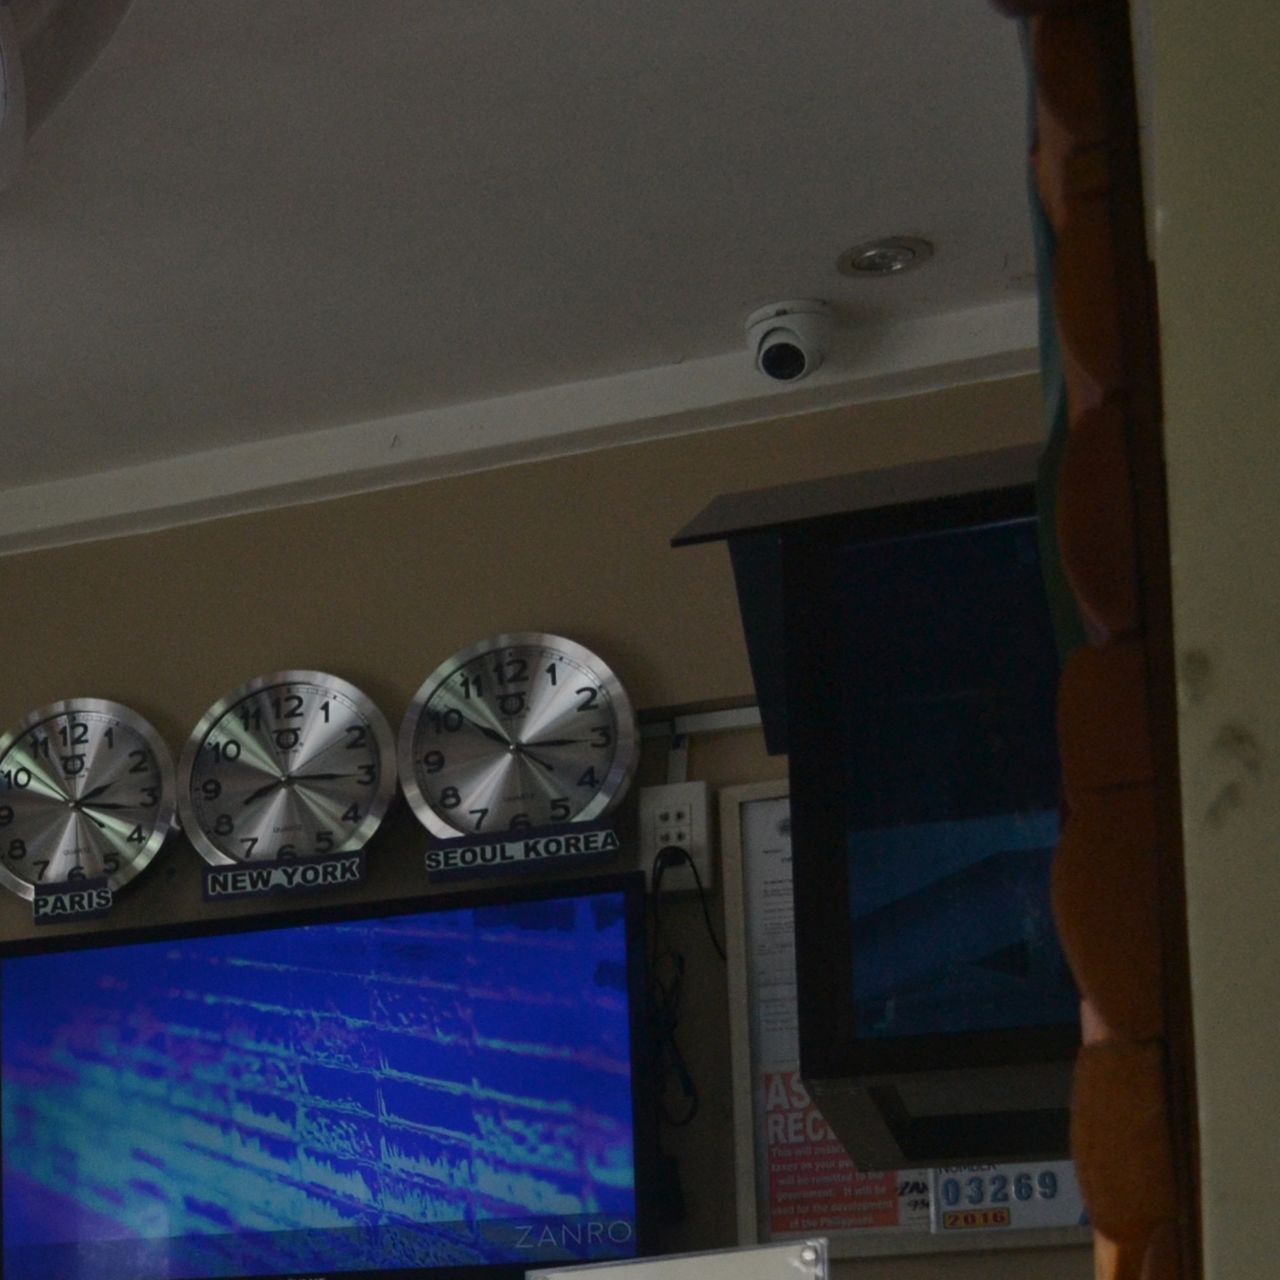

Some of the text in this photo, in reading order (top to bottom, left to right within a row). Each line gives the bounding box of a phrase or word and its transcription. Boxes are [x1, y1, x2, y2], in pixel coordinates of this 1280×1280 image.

[493, 659, 529, 685] 12
[545, 663, 557, 686] 1
[460, 675, 483, 699] 11
[272, 696, 304, 719] 12
[576, 687, 598, 712] 2
[240, 706, 261, 731] 11
[320, 701, 330, 723] 1
[431, 709, 463, 733] 10
[30, 733, 49, 758] 11
[59, 723, 89, 746] 12
[104, 728, 113, 748] 1
[345, 725, 366, 749] 2
[591, 726, 610, 748] 3
[128, 751, 148, 773] 2
[211, 740, 240, 763] 10
[424, 751, 445, 774] 9
[3, 767, 31, 789] 10
[357, 764, 375, 785] 3
[576, 766, 599, 788] 4
[141, 788, 158, 807] 3
[202, 779, 221, 800] 9
[441, 786, 461, 809] 8
[343, 804, 362, 824] 4
[469, 808, 489, 831] 7
[550, 797, 570, 820] 5
[127, 825, 145, 843] 4
[214, 814, 234, 836] 8
[8, 839, 26, 860] 8
[240, 838, 258, 858] 7
[316, 831, 334, 853] 5
[425, 830, 620, 872] SEOUL KOREA
[34, 861, 50, 880] 7
[103, 853, 120, 874] 5
[208, 858, 361, 895] NEW YORK
[33, 889, 113, 916] PARIS
[768, 1111, 837, 1145] REC
[943, 1171, 1059, 1206] 03269
[947, 1210, 1007, 1228] 2016
[514, 1220, 633, 1249] ZANRO
